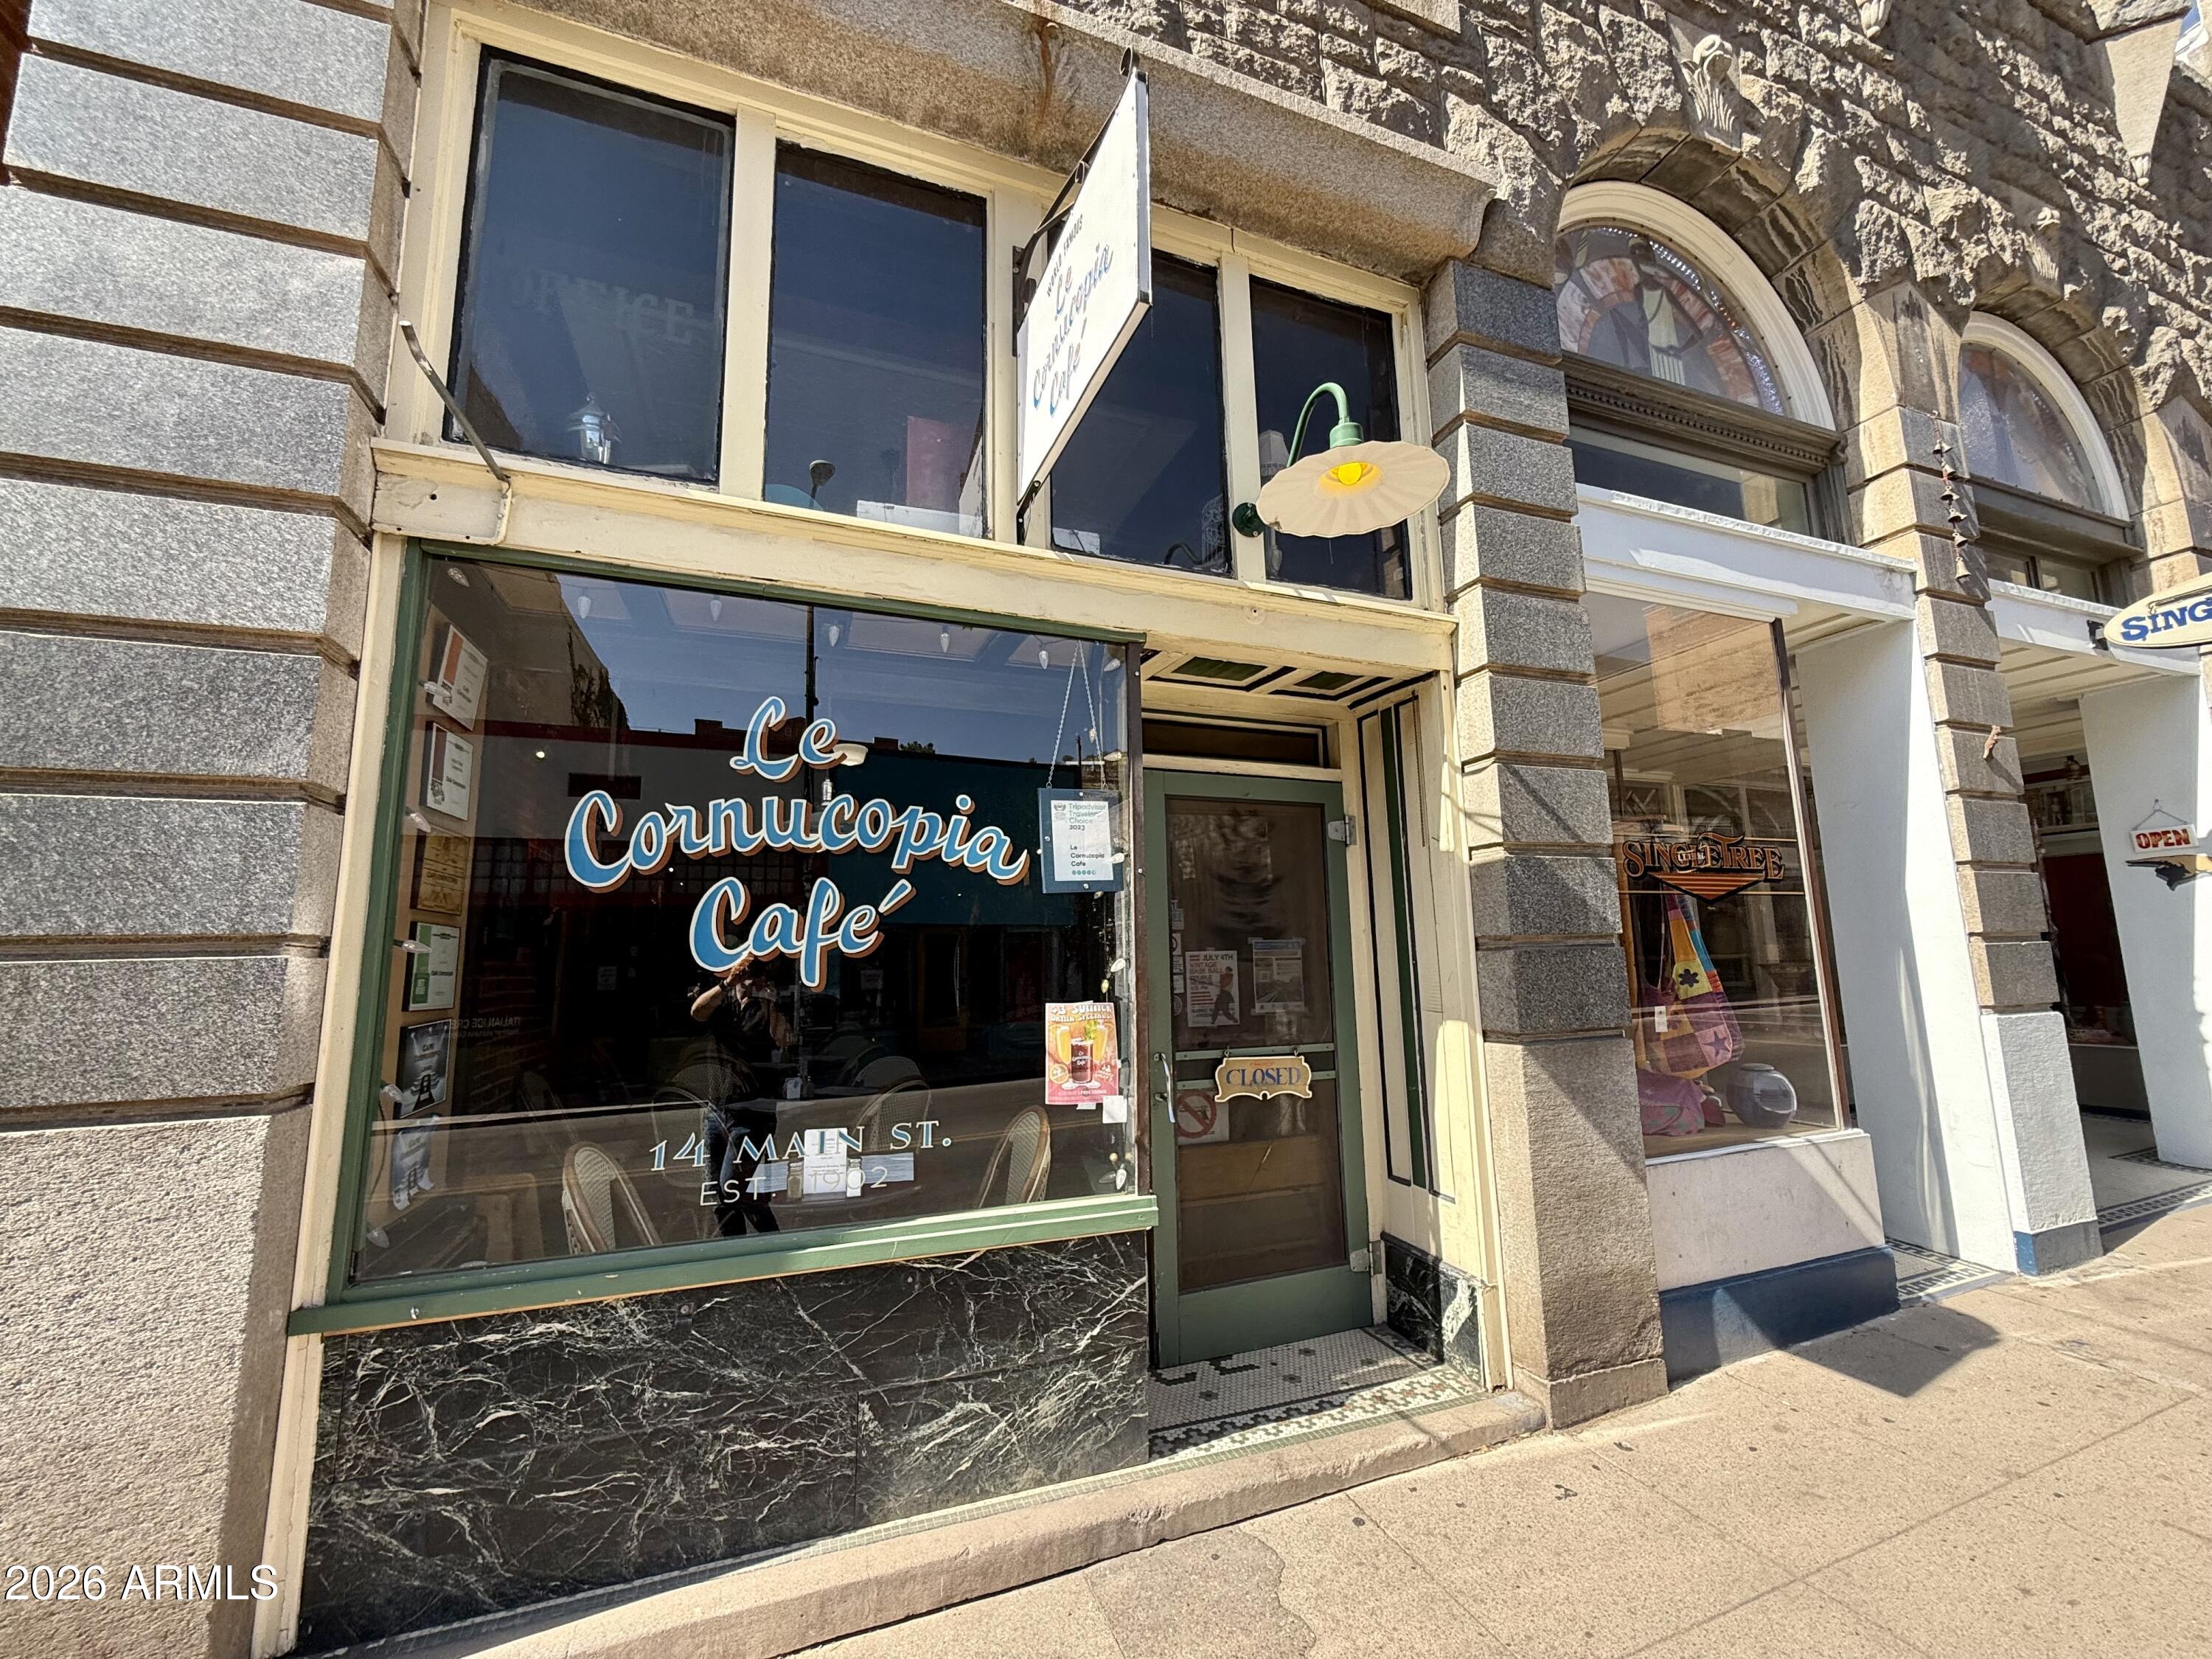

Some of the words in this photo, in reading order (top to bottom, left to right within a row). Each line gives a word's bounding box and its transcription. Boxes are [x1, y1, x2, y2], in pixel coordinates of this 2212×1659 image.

[1046, 253, 1062, 297] WORLD
[1063, 213, 1083, 255] FAMOUS
[1054, 265, 1073, 321] Le
[1033, 243, 1114, 410] Cornucopia
[2121, 596, 2212, 641] SING
[729, 695, 844, 782] Le
[1068, 802, 1106, 810] Tripadvisor
[564, 789, 1030, 892] Cornucopia
[2135, 828, 2191, 849] OPEN
[689, 876, 916, 992] Café
[1051, 1005, 1067, 1015] $3
[1225, 1067, 1301, 1086] CLOSED
[649, 1132, 711, 1171] 14
[733, 1126, 866, 1164] MAIN
[890, 1120, 953, 1150] ST.
[700, 1175, 776, 1206] EST.
[811, 1166, 888, 1192] 1902
